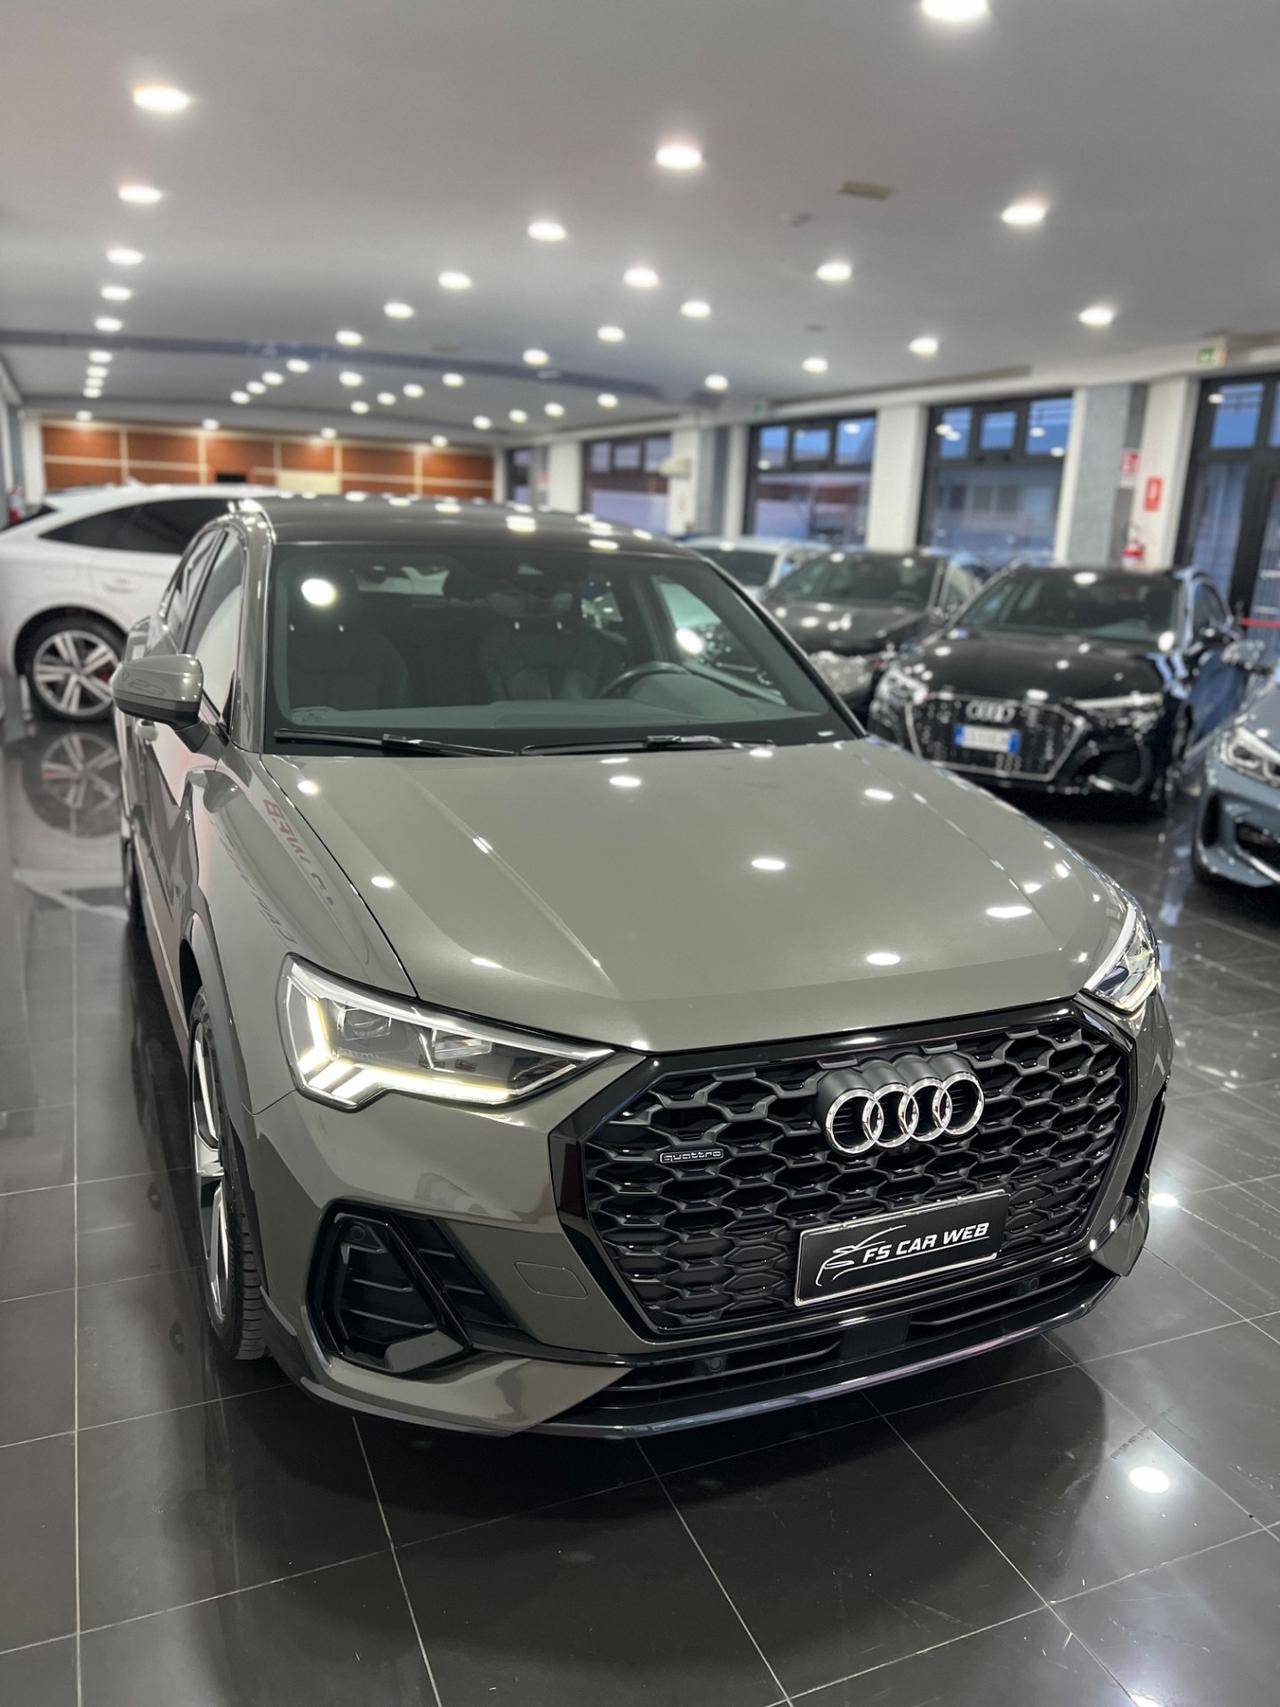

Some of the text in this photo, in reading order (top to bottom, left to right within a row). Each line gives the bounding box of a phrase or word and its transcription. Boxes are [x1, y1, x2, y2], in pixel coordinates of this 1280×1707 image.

[663, 1151, 721, 1163] quattro
[862, 1222, 990, 1264] FS CAR WEB
